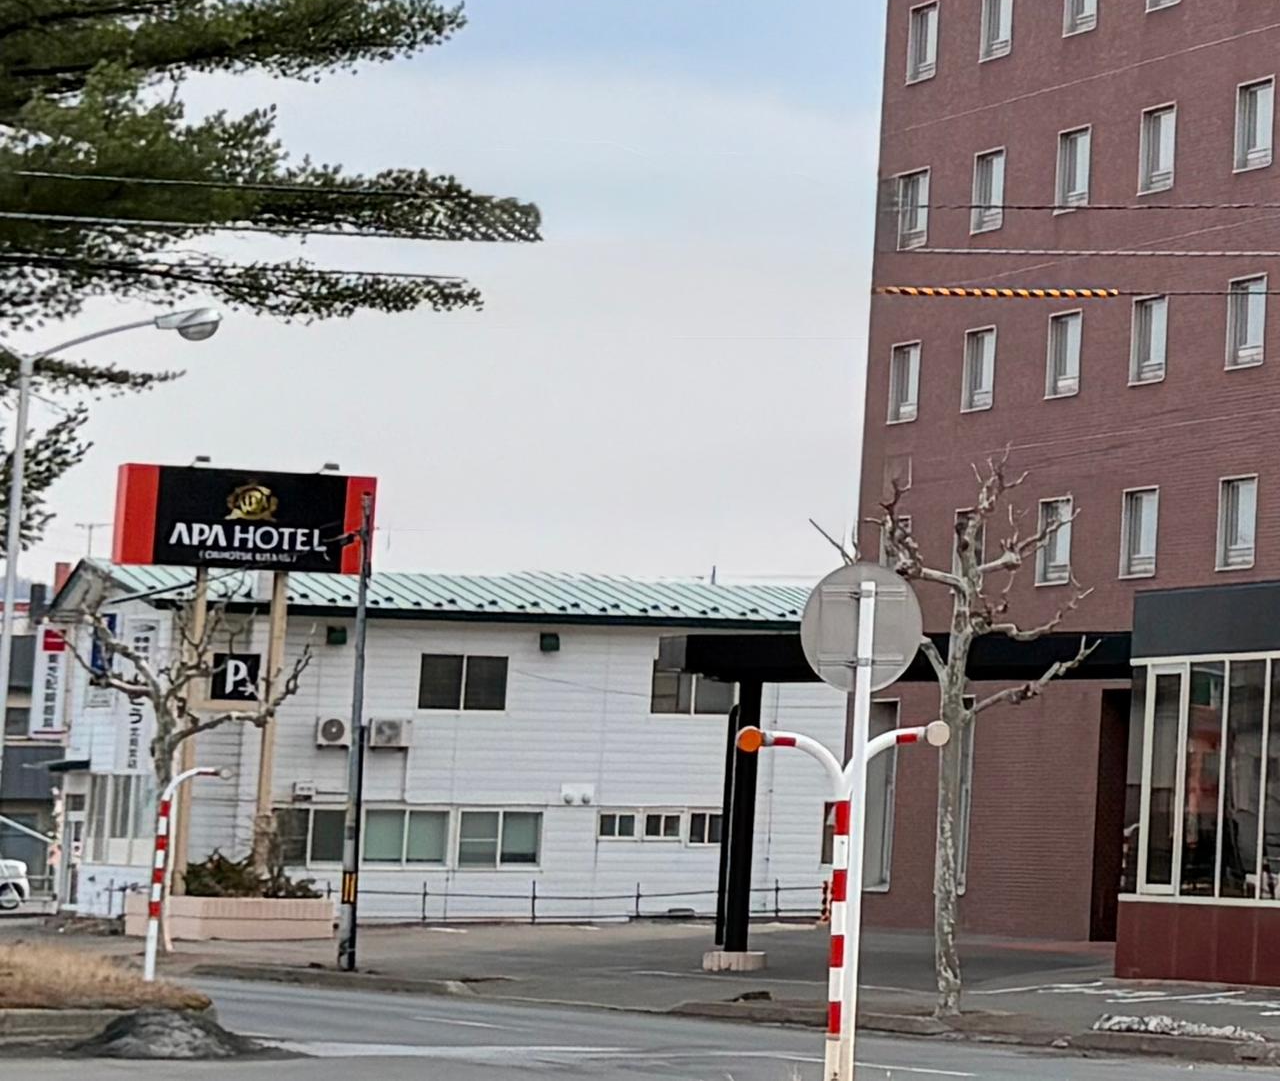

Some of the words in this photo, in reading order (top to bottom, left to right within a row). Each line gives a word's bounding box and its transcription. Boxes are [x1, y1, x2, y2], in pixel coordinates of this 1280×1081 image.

[169, 522, 227, 547] APA
[233, 526, 327, 552] HOTEL
[225, 659, 248, 694] P
